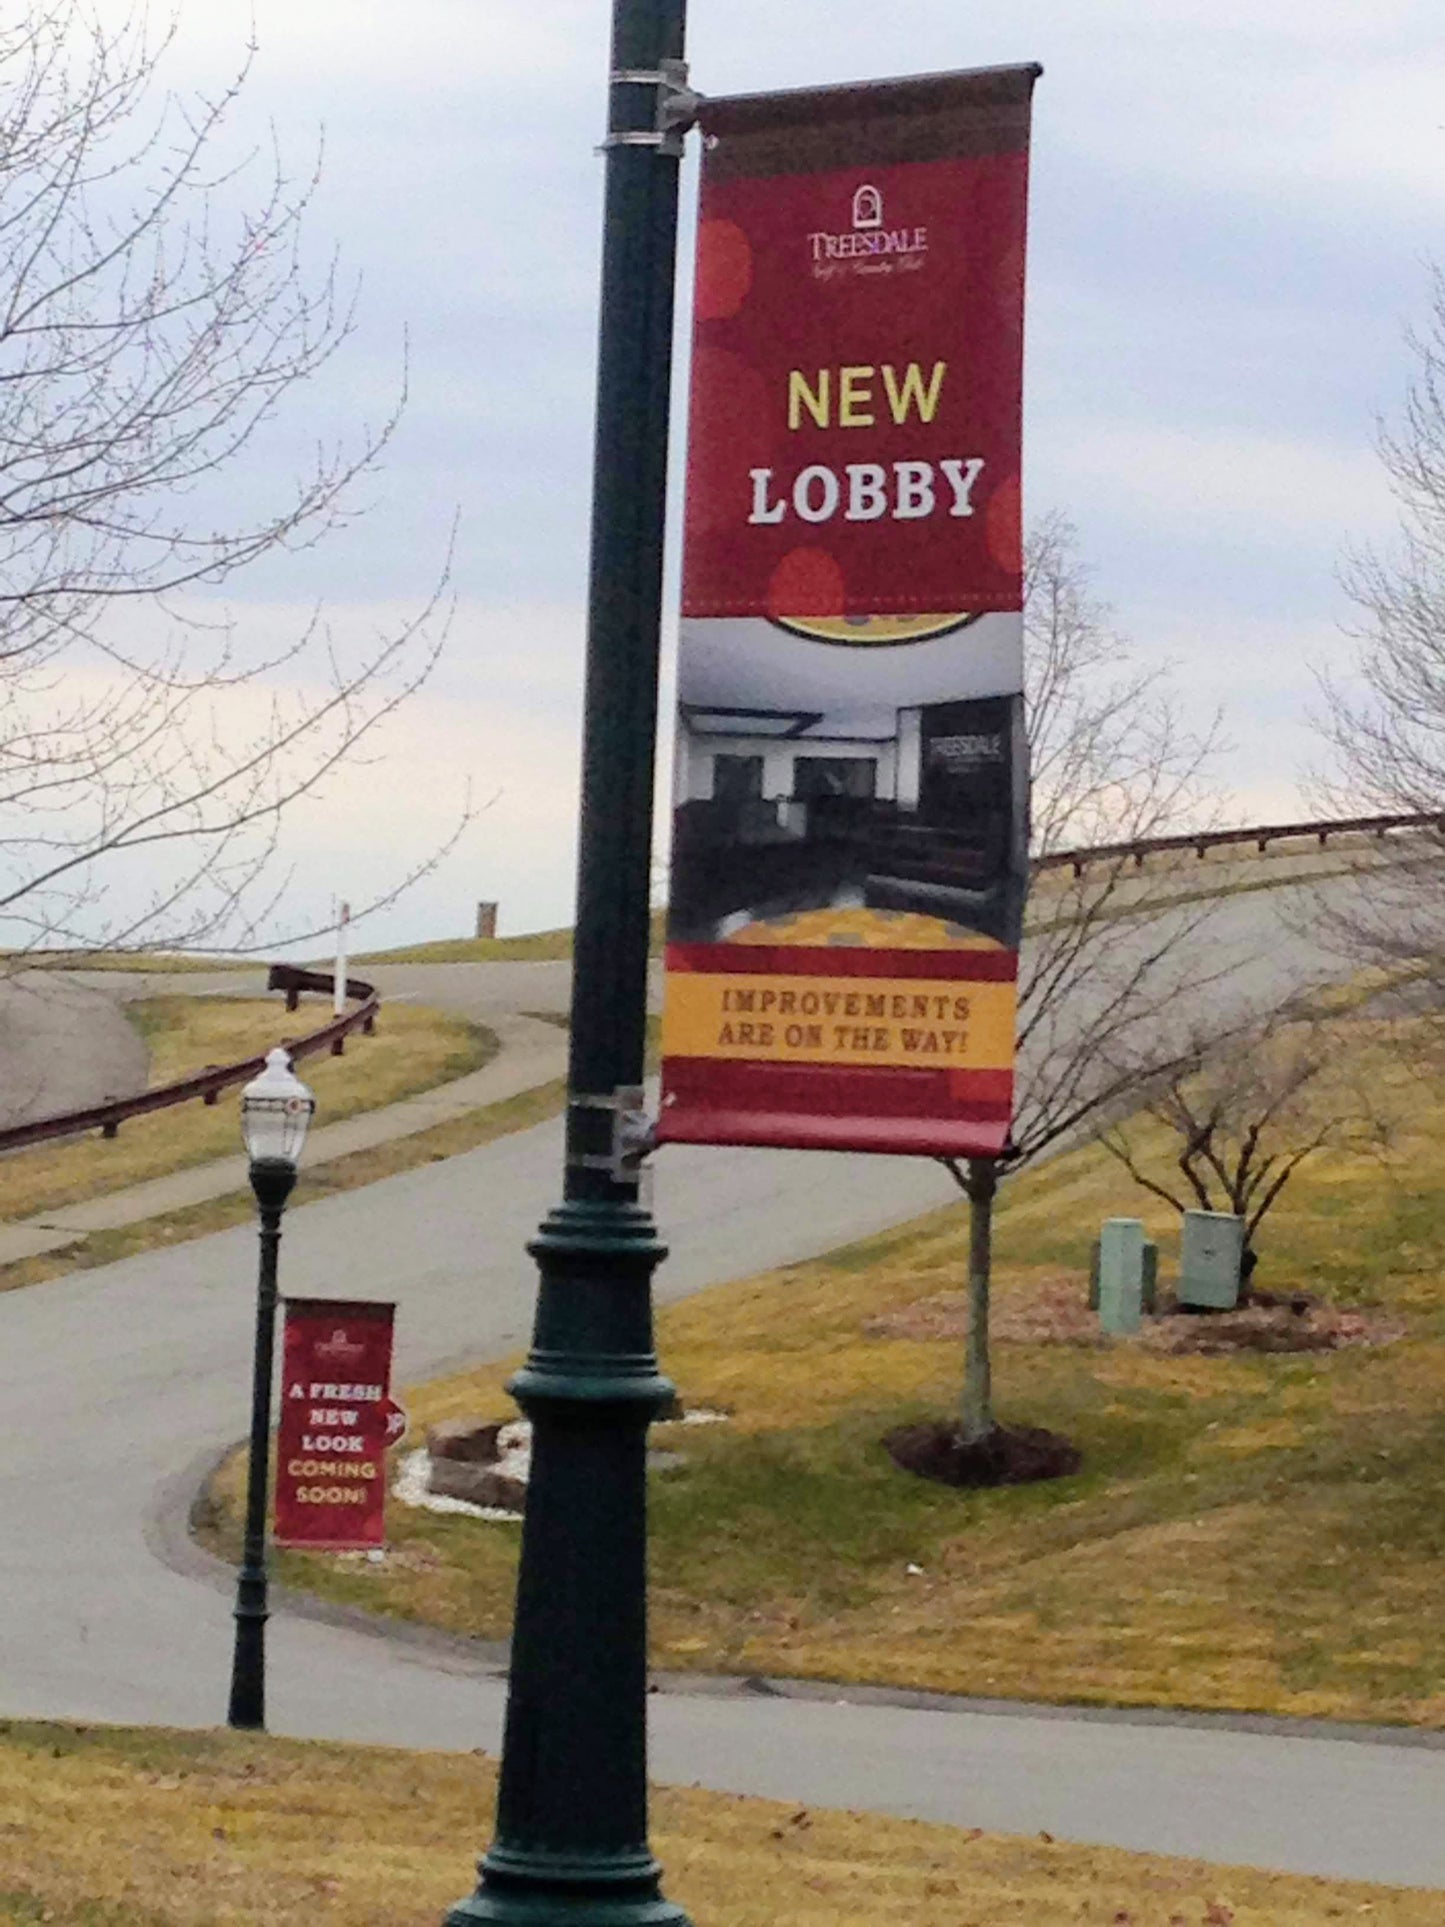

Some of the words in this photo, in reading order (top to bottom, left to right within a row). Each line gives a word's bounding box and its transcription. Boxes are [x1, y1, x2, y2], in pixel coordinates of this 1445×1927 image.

[807, 228, 928, 261] TREESDALE
[788, 362, 947, 430] NEW
[749, 458, 984, 525] LOBBY
[722, 989, 970, 1020] IMPROVEMENTS
[719, 1025, 774, 1048] ARE
[785, 1027, 823, 1049] ON
[834, 1028, 889, 1052] THE
[901, 1030, 968, 1054] WAY!
[290, 1385, 304, 1399] A
[310, 1384, 382, 1401] FRESH
[310, 1410, 359, 1427] NEW
[303, 1436, 363, 1452] LOOK
[288, 1460, 376, 1479] COMING
[296, 1487, 366, 1504] SOON!
